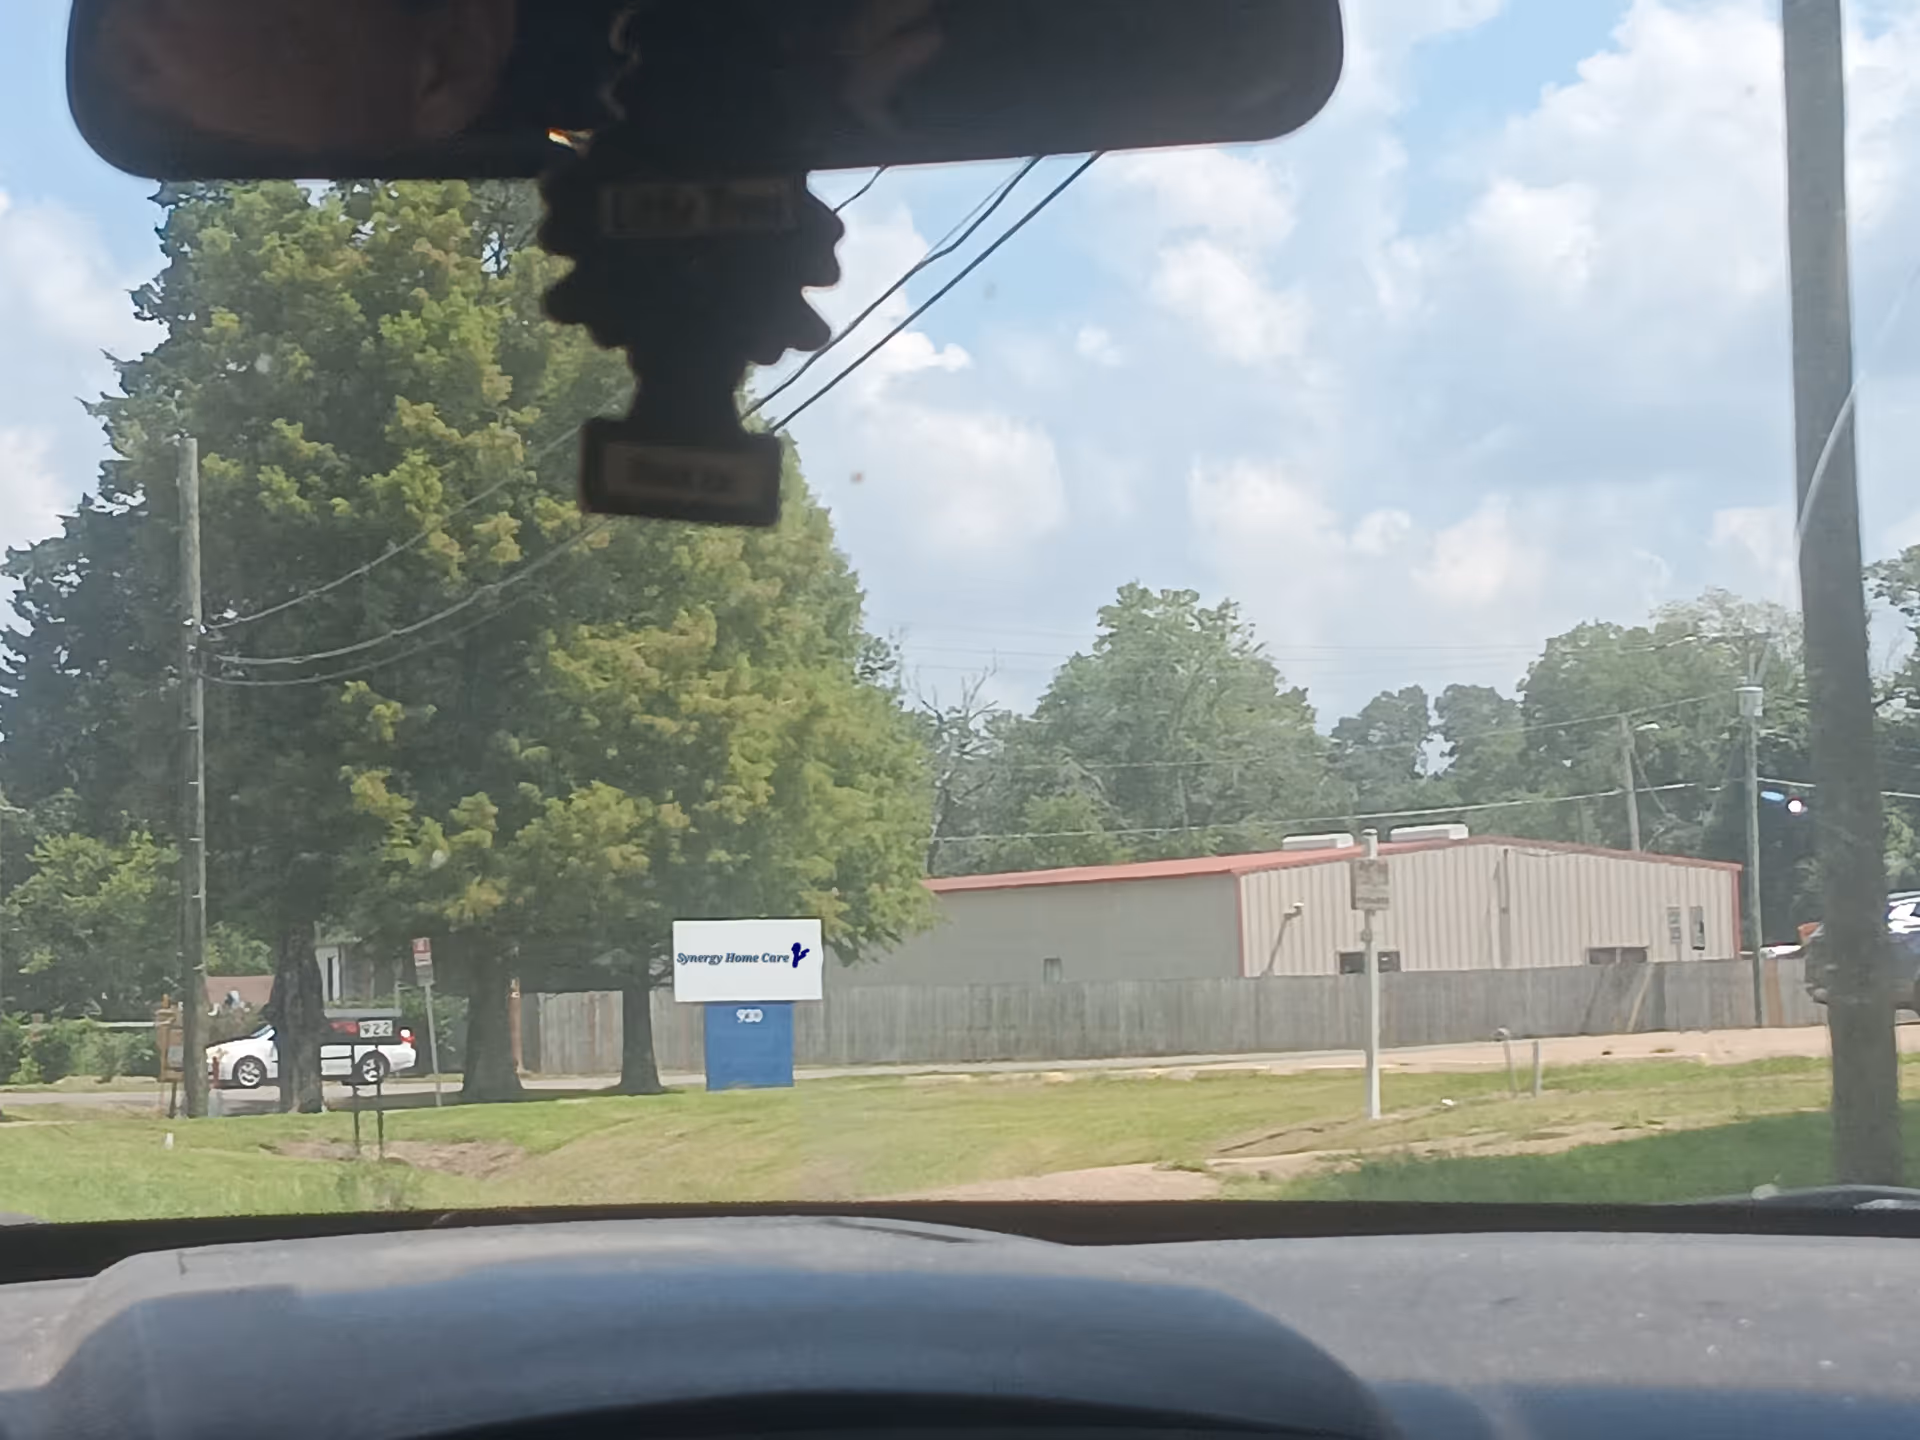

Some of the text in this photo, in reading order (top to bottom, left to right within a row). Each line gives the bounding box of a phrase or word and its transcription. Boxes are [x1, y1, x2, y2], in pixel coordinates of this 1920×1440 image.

[676, 952, 790, 965] Synergy Home Care
